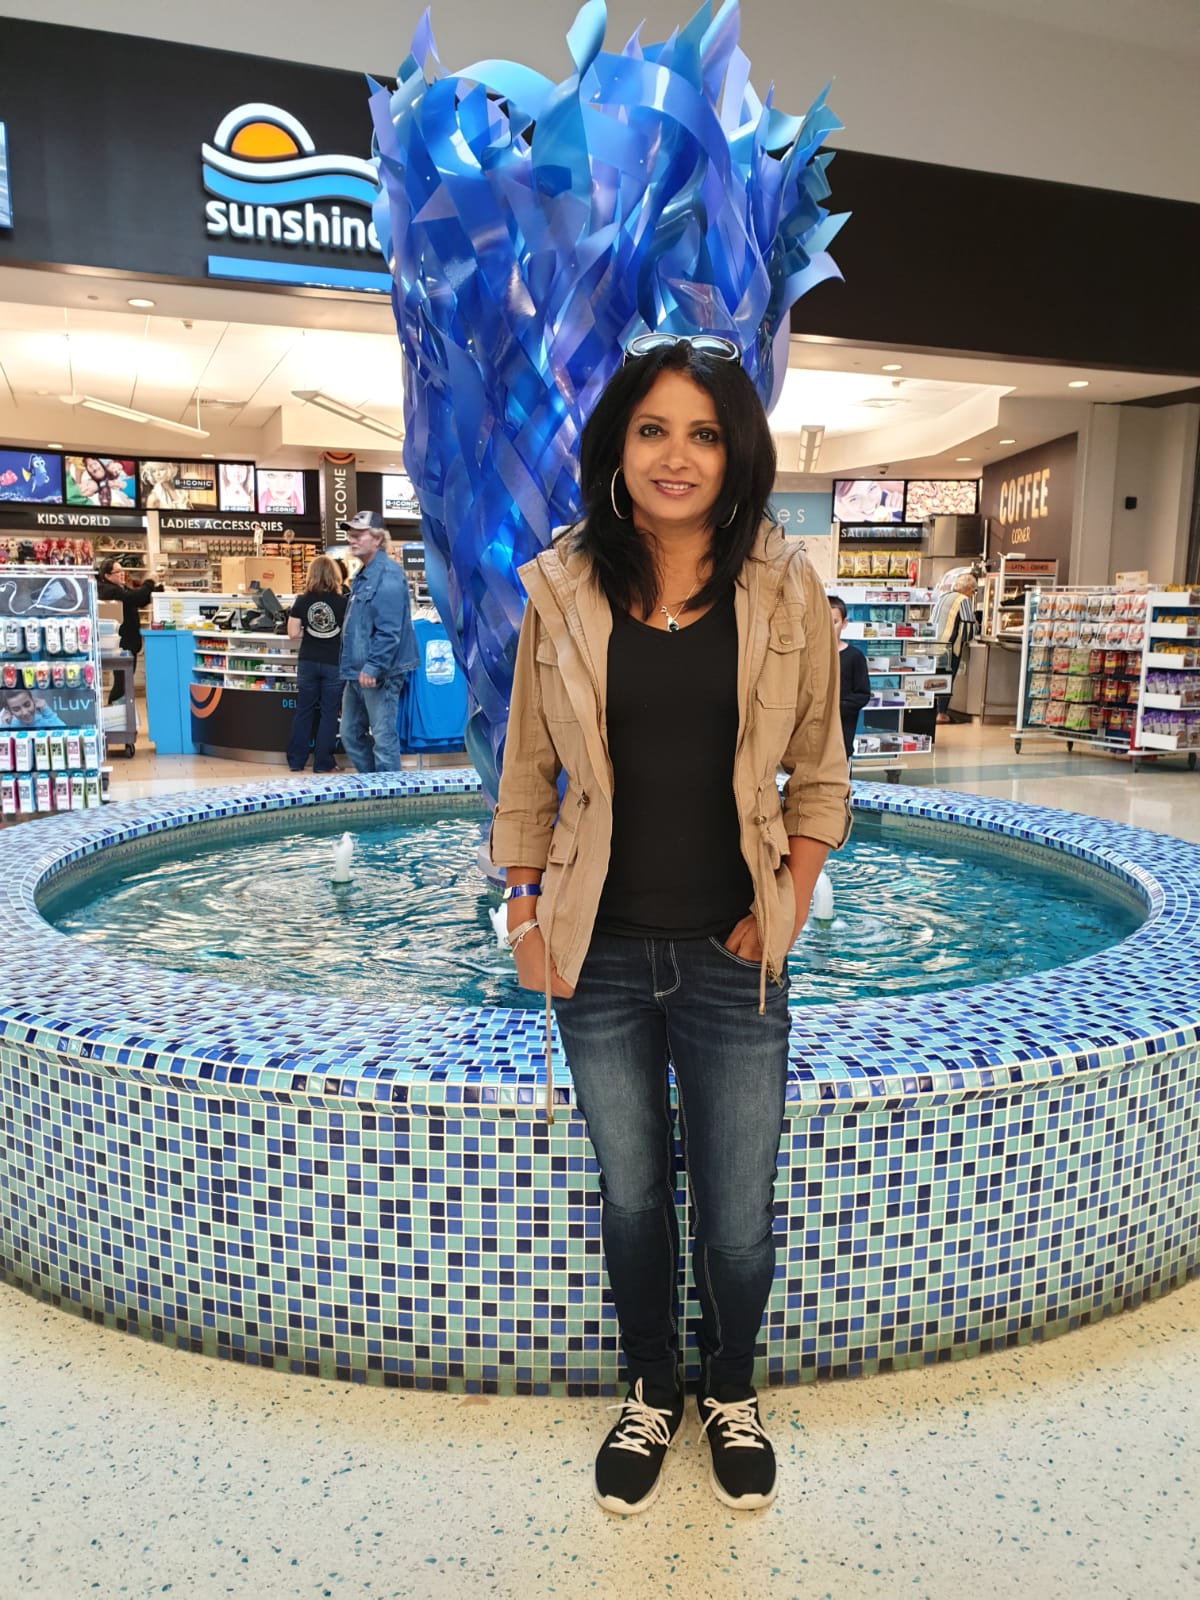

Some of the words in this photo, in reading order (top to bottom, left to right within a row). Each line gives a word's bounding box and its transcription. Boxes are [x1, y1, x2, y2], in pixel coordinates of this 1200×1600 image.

[1000, 467, 1050, 525] COFFEE
[37, 513, 65, 525] KIDS
[68, 514, 111, 526] WORLD
[161, 518, 201, 529] LADIES
[204, 519, 284, 531] ACCESSORIES
[840, 528, 870, 538] SALTY
[1011, 526, 1031, 544] CORNER
[53, 696, 91, 711] iLuv
